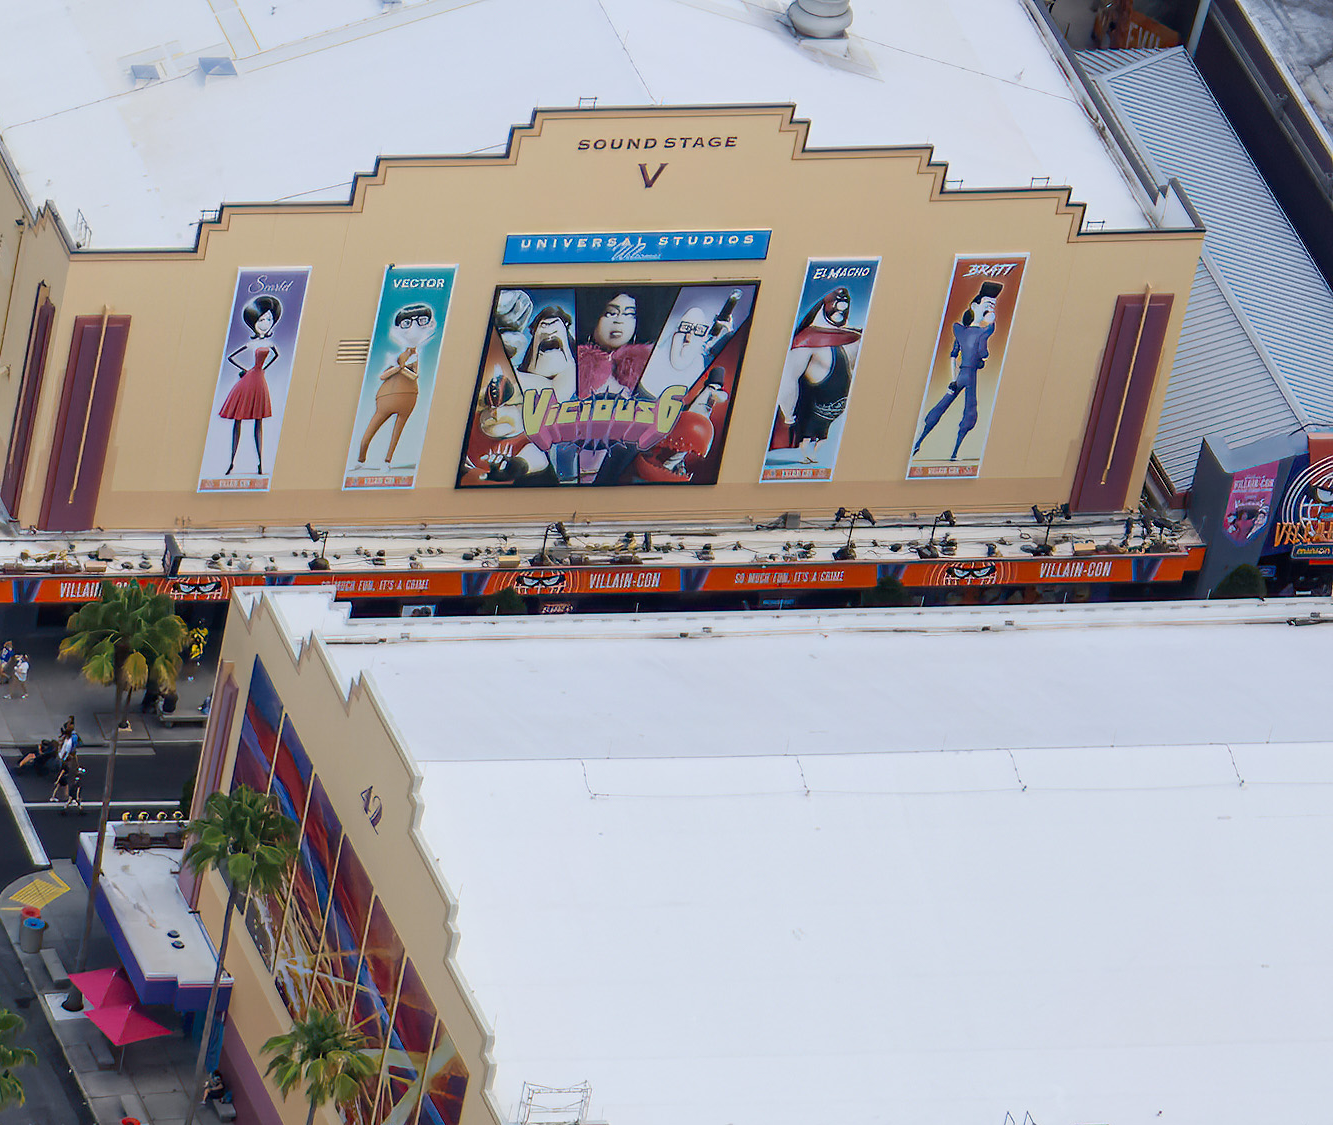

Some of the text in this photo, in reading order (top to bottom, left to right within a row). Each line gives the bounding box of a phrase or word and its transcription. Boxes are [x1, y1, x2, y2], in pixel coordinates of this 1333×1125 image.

[577, 136, 738, 150] SOUND STAGE
[638, 162, 669, 189] V
[521, 235, 755, 249] UNIVERSAL STUDIOS
[962, 263, 1018, 278] BRATT
[393, 278, 445, 288] VECTOR
[1039, 561, 1112, 578] VILLAIN-CON
[589, 572, 661, 589] VILLAIN-CON
